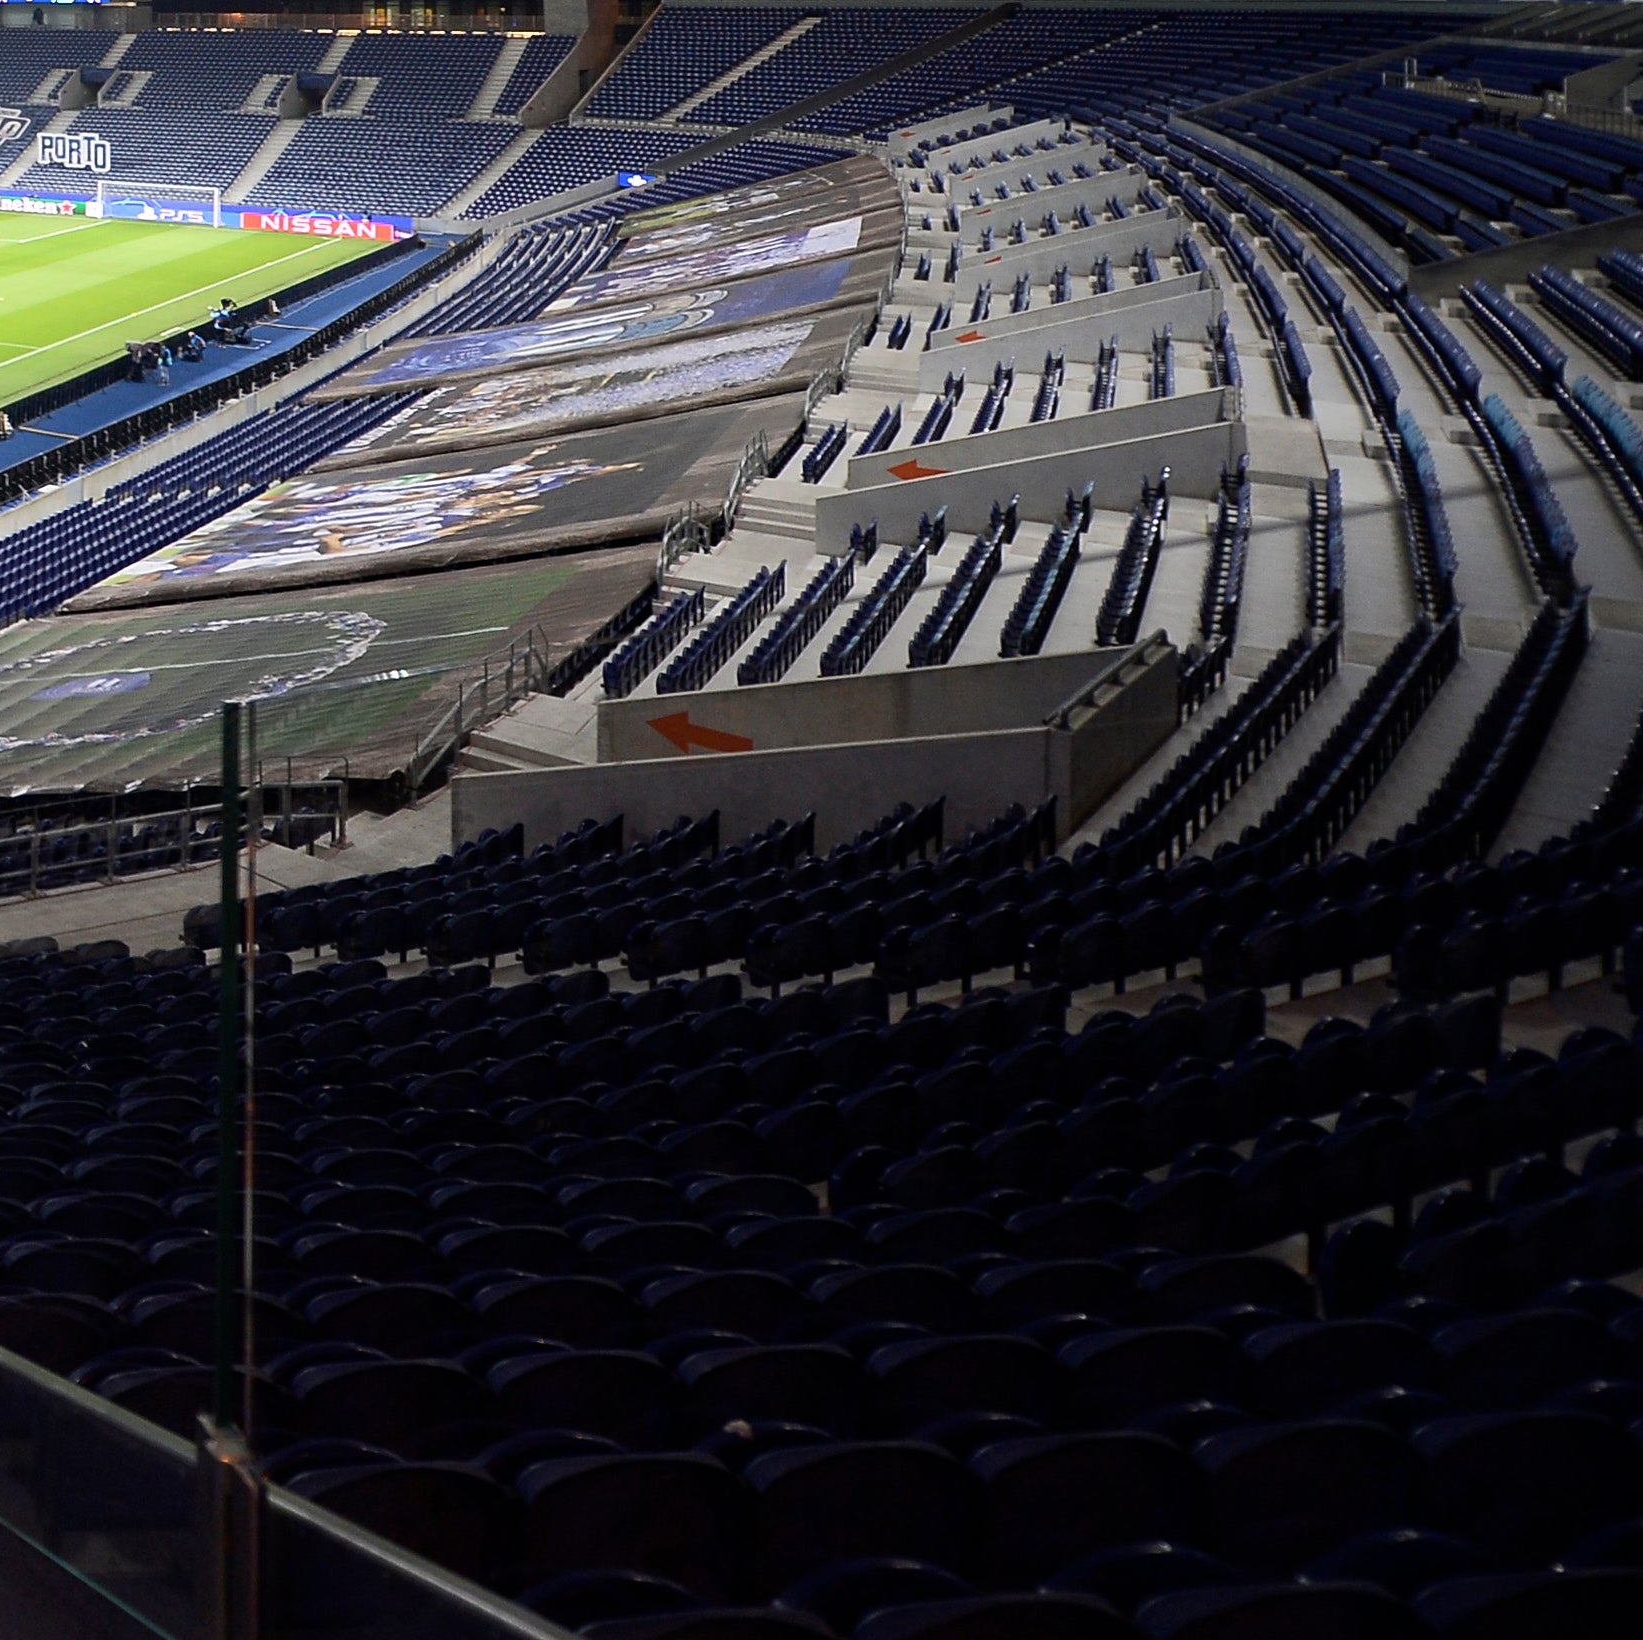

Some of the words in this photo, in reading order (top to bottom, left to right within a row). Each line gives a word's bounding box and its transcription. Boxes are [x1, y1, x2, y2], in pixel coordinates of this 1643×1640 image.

[40, 135, 107, 170] PORTO
[160, 208, 204, 223] PS5
[260, 215, 377, 239] NISSAN
